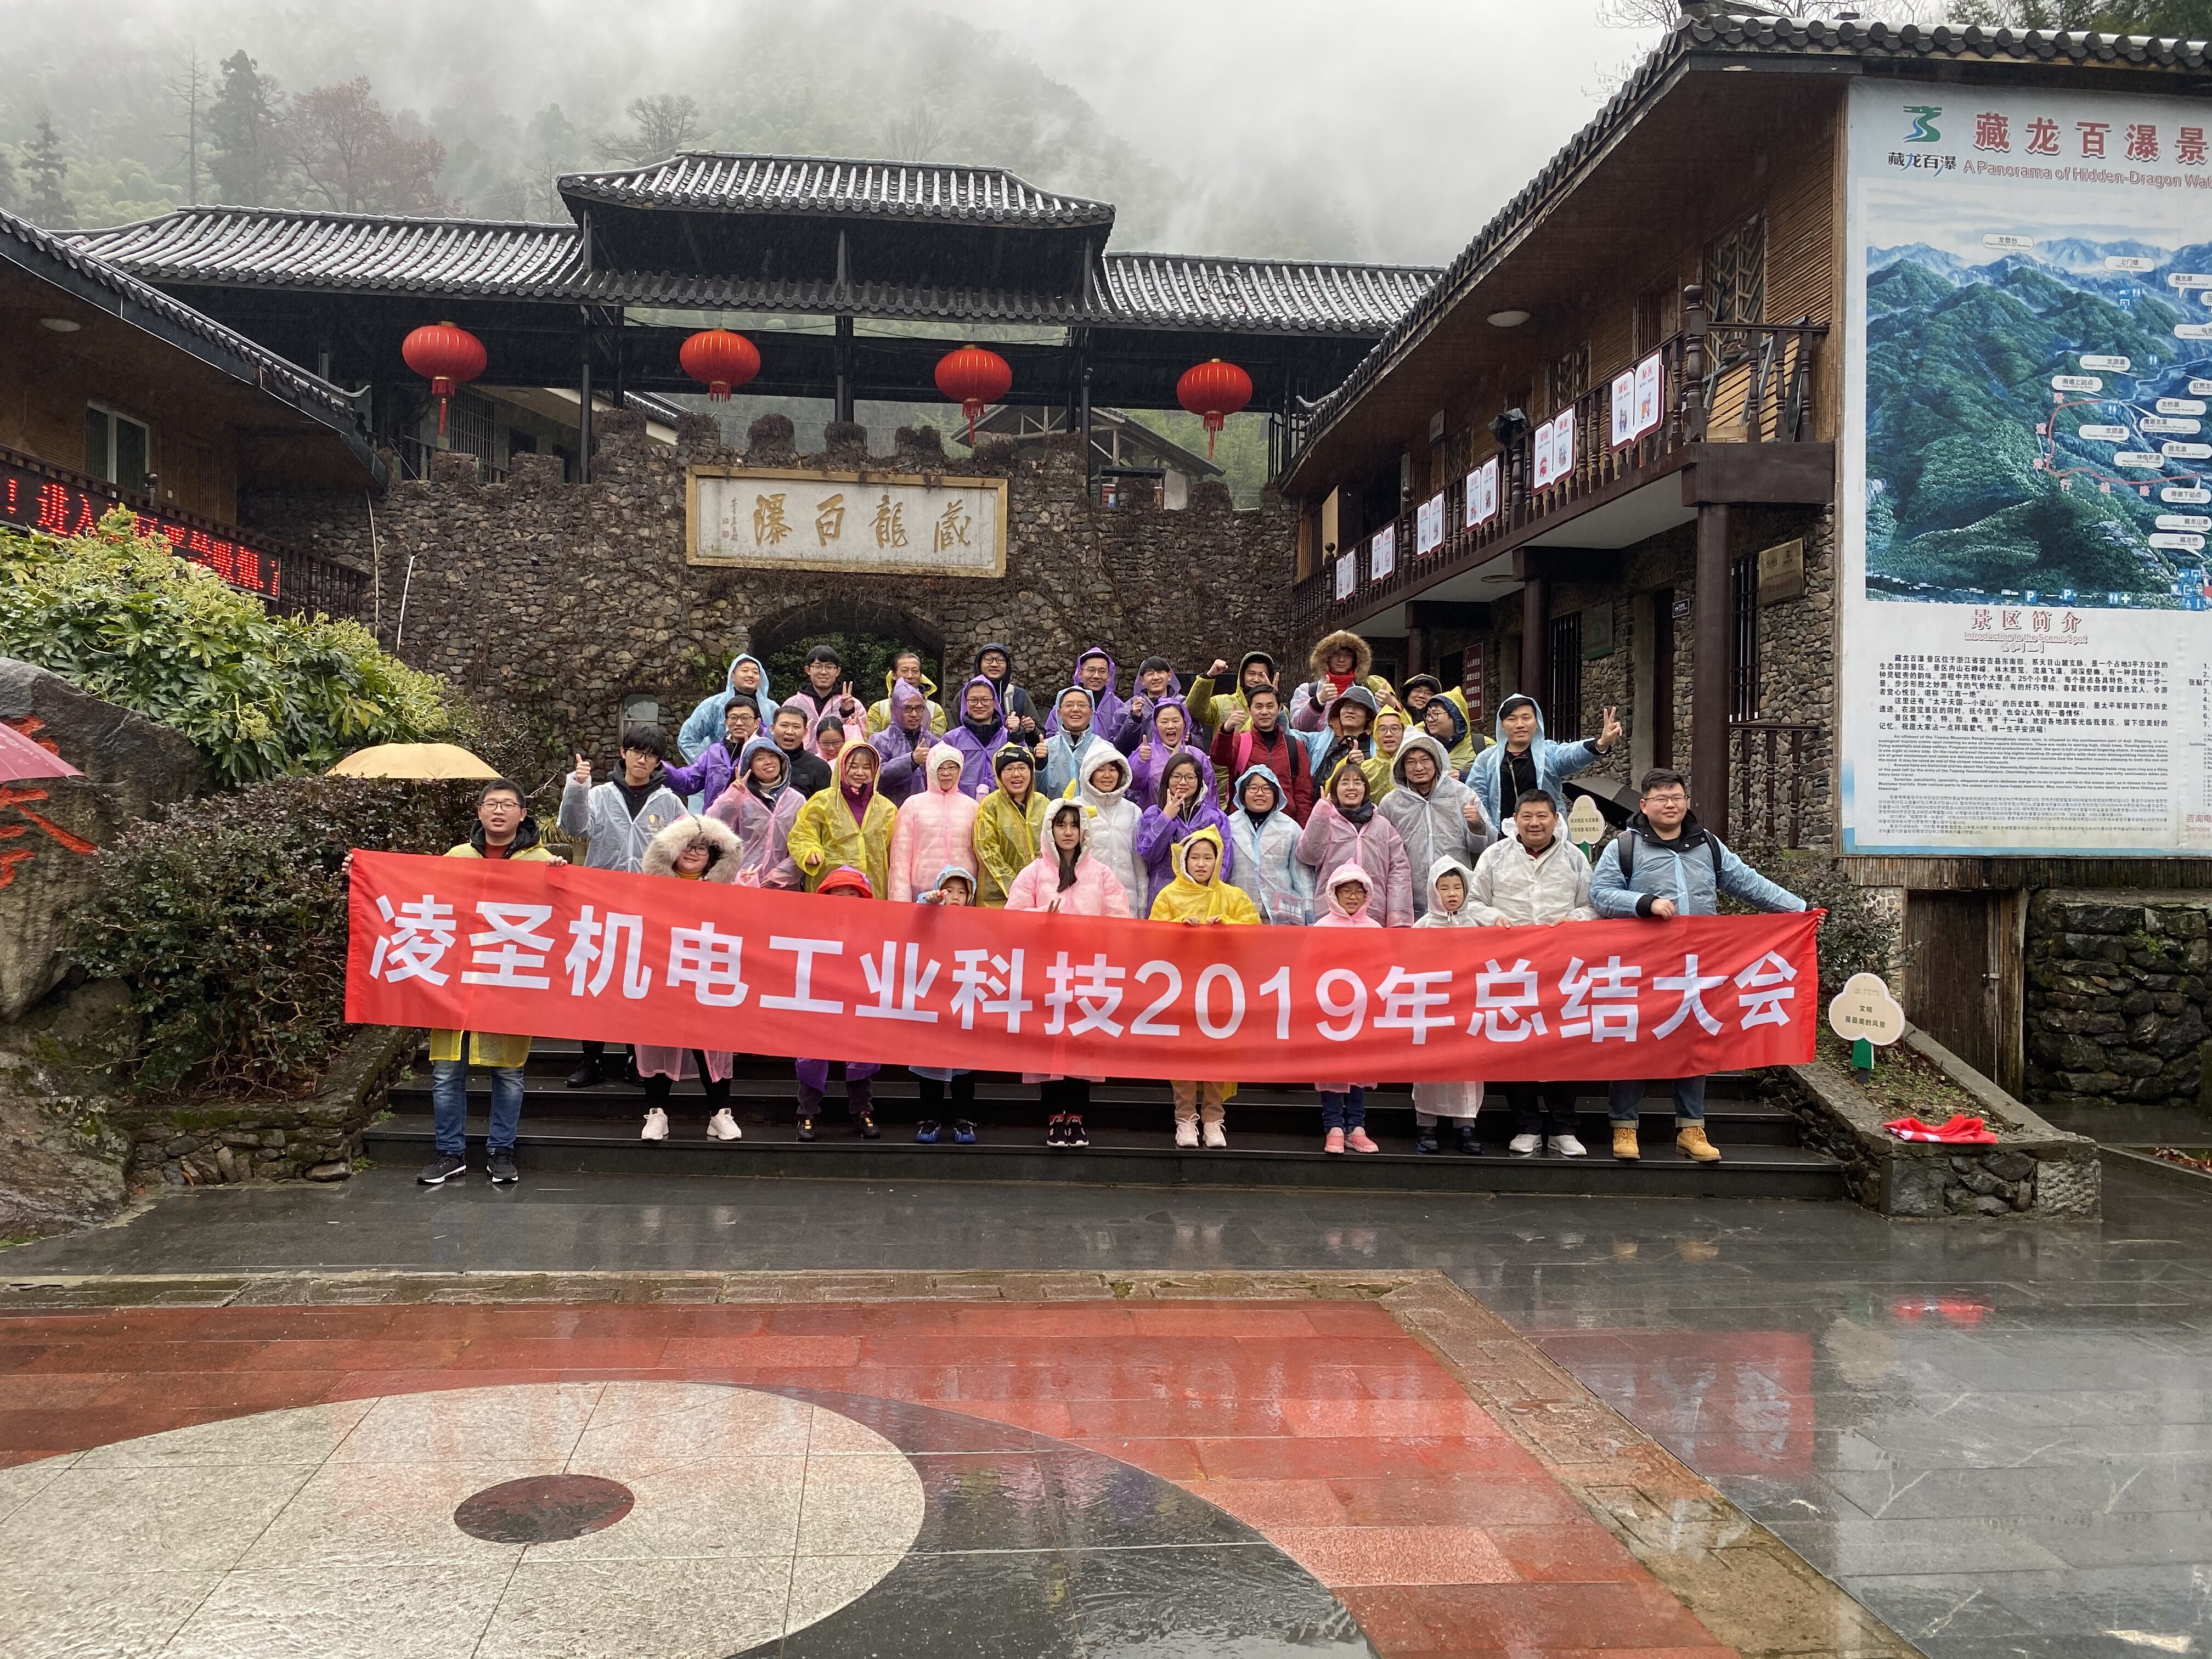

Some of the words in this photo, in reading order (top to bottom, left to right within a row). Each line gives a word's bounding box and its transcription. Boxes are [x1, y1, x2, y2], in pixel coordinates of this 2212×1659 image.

[1974, 112, 2209, 165] 藏龙百瀑景
[1888, 151, 1957, 177] 藏龙百瀑
[1963, 160, 1975, 173] A
[1977, 160, 2052, 179] Panorama
[2055, 167, 2070, 180] of
[2073, 167, 2181, 189] Hidden-Dragon
[1972, 608, 2082, 633] 景区简介
[1965, 631, 2014, 642] Introduction
[2015, 633, 2024, 642] to
[2024, 633, 2038, 642] the
[2039, 634, 2067, 643] Scenic
[2067, 634, 2087, 645] Spot
[369, 894, 1798, 1045] 凌圣机电工业科技2019年总结大会
